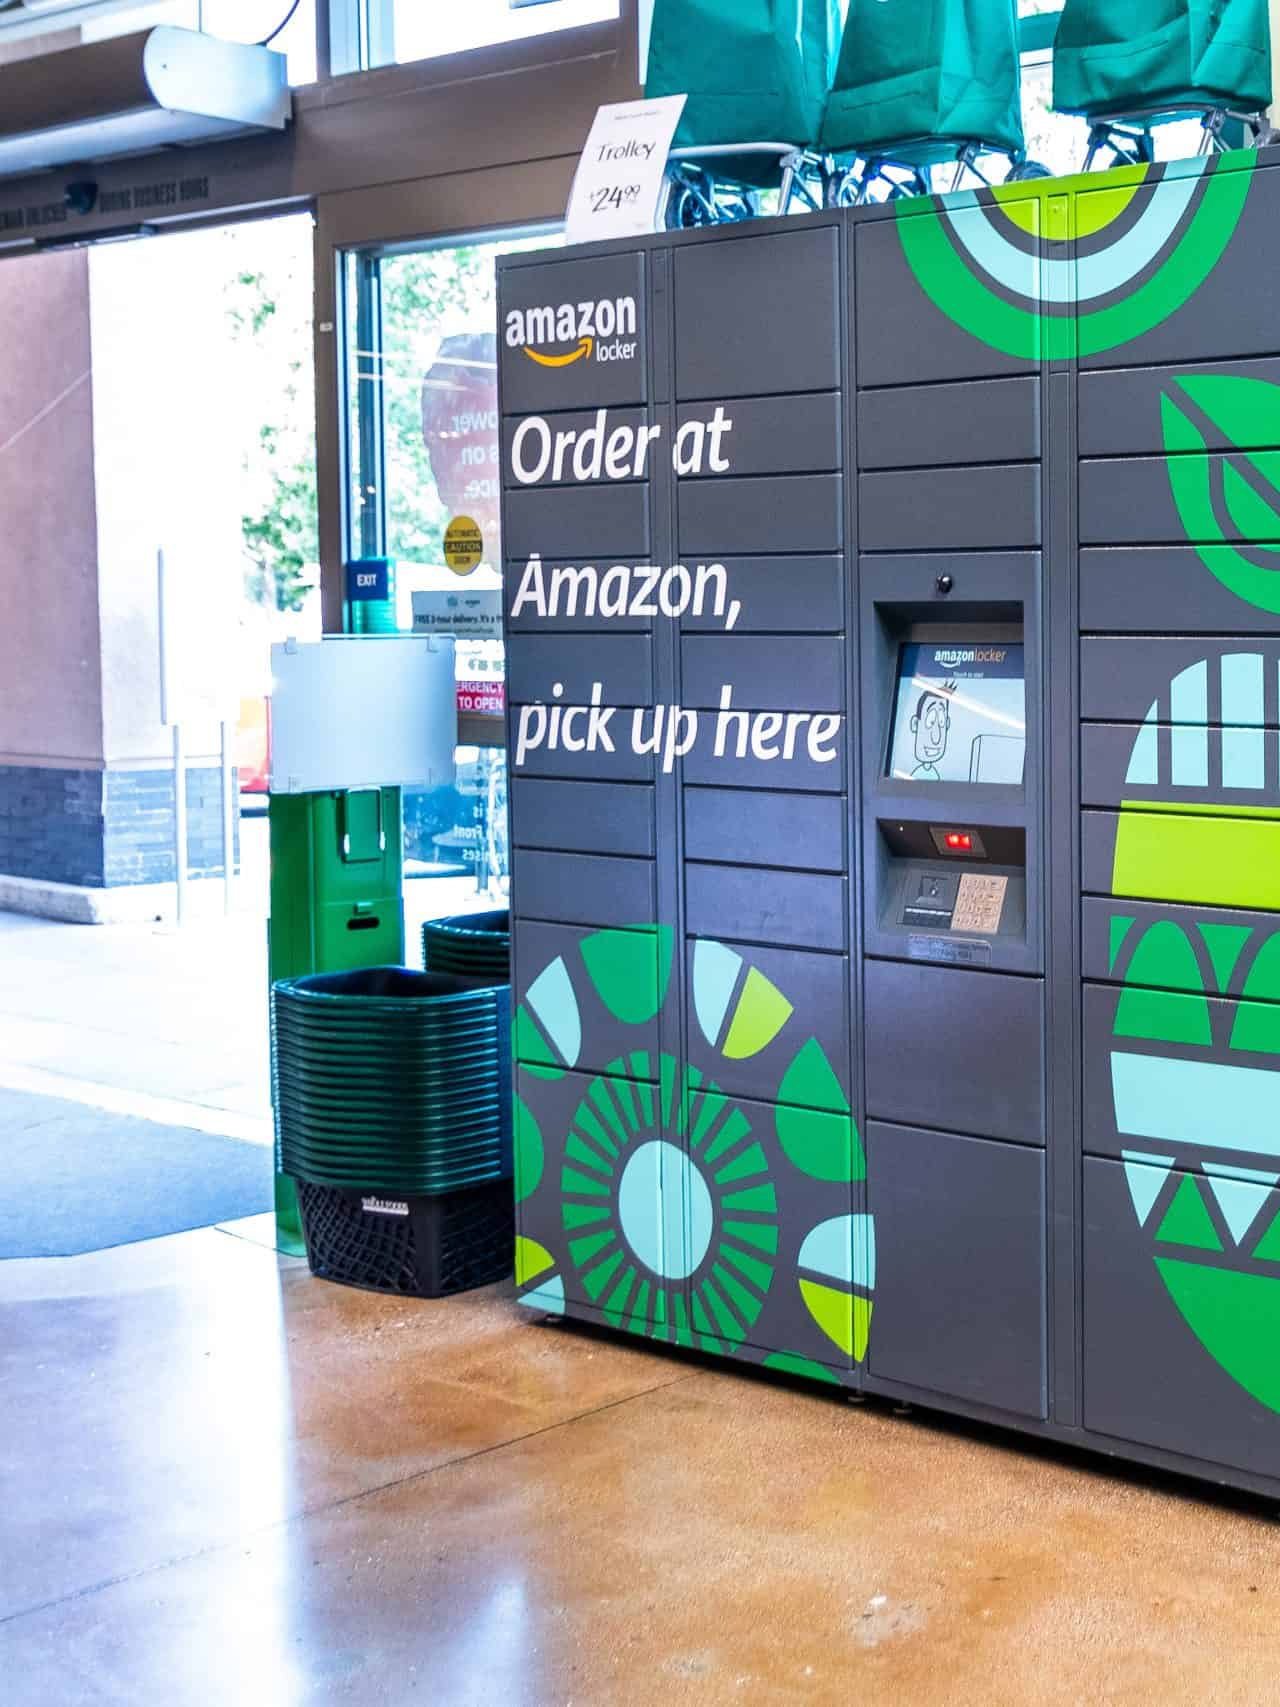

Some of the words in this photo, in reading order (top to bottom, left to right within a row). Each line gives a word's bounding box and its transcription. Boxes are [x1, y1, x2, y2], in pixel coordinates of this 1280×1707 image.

[597, 139, 657, 161] Trolley
[505, 296, 637, 347] amazon
[596, 339, 637, 362] locker
[511, 408, 662, 485] Order
[672, 407, 733, 476] at
[356, 573, 377, 587] EXIT
[510, 553, 742, 630] Amazon,
[459, 696, 474, 709] TO
[475, 697, 503, 710] OPEN
[515, 681, 617, 766] pick
[631, 704, 698, 773] up
[714, 684, 842, 762] here
